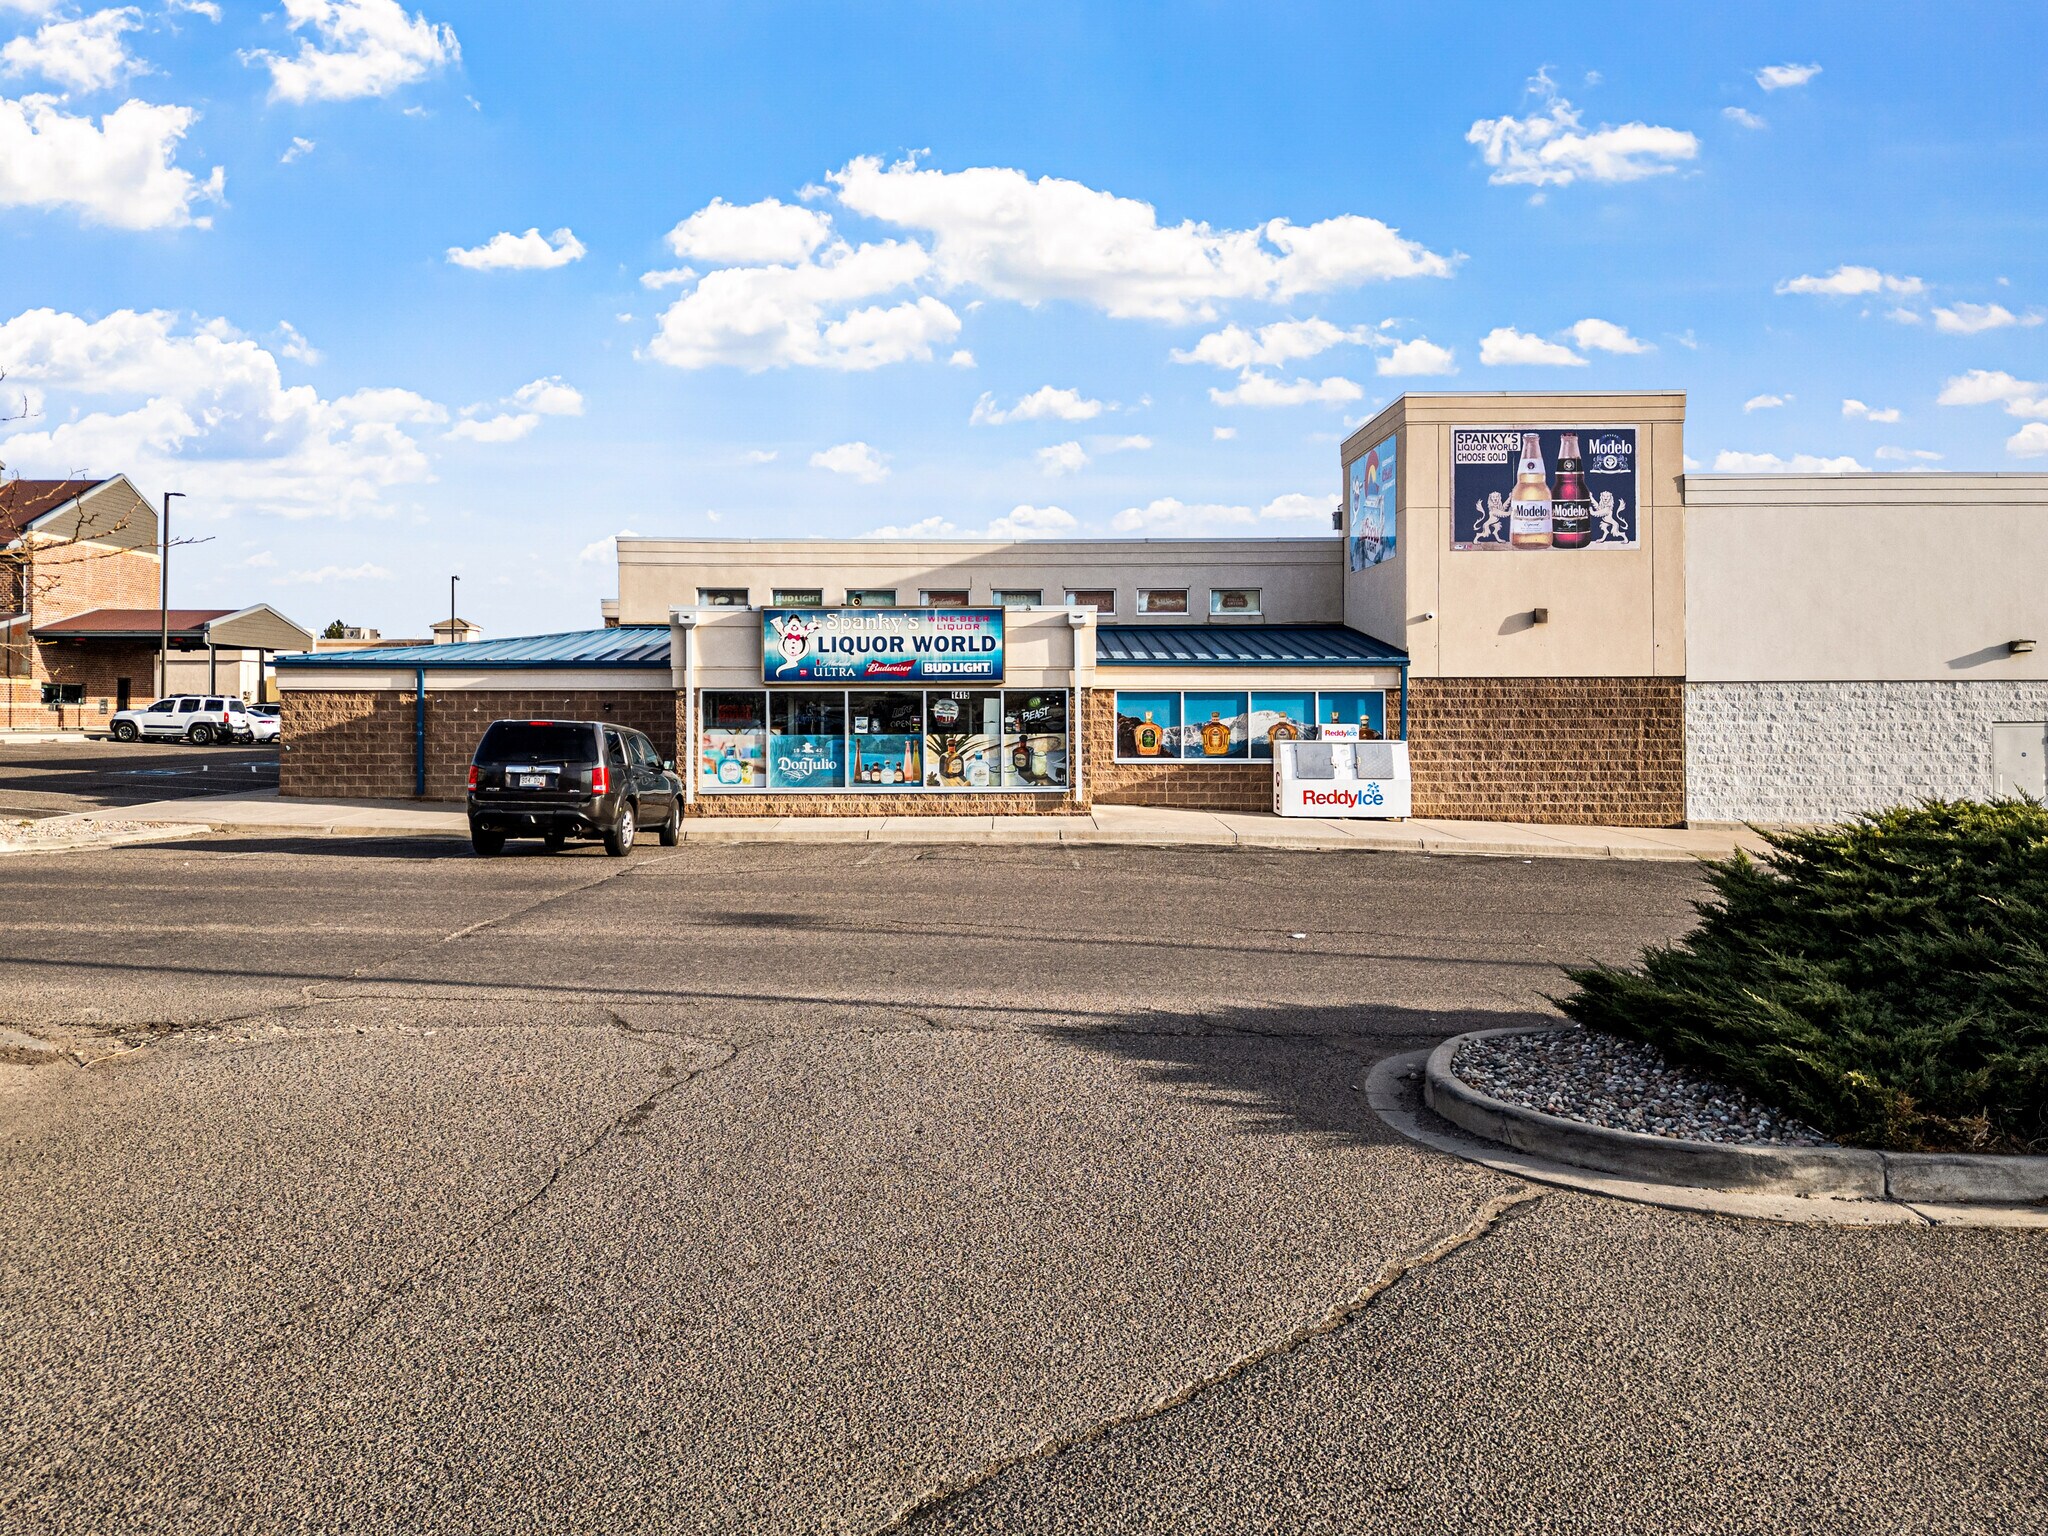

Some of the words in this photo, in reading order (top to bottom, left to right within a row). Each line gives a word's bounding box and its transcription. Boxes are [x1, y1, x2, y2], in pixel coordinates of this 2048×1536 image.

[1457, 433, 1518, 444] SPANKY'S
[1457, 443, 1487, 452] LIQUOR
[1489, 443, 1519, 451] WORLD
[1588, 439, 1633, 455] Modelo
[1457, 452, 1486, 462] CHOOSE
[1487, 452, 1507, 462] GOLD
[1516, 504, 1547, 517] Modelo
[1554, 504, 1586, 517] Modelo
[775, 594, 795, 602] BUD
[795, 594, 821, 602] LIGHT
[826, 613, 920, 634] Spanky's
[927, 615, 990, 623] WINE-BEER
[936, 623, 980, 631] LIQUOR
[817, 635, 905, 656] LIQUOR
[912, 635, 997, 653] WORLD
[813, 667, 857, 677] ULTRA
[866, 663, 912, 673] Budweiser
[924, 662, 952, 673] BUD
[952, 662, 991, 673] LIGHT
[952, 691, 970, 700] 1415
[1022, 706, 1050, 722] BEAST
